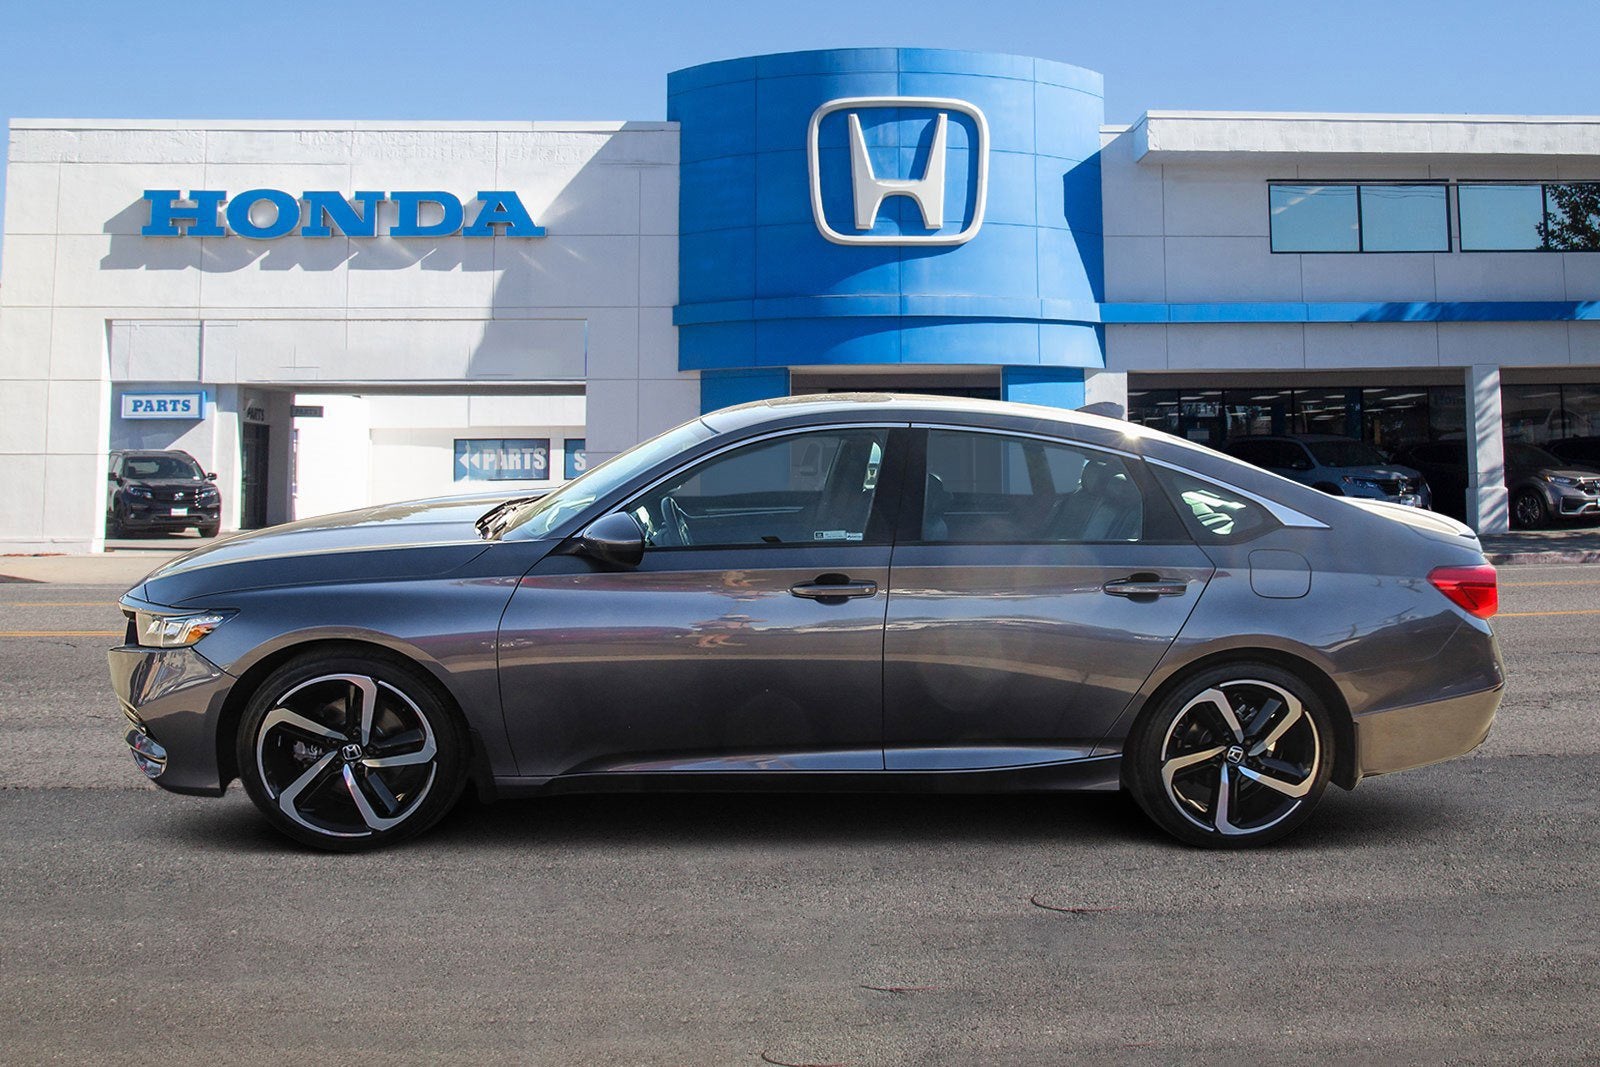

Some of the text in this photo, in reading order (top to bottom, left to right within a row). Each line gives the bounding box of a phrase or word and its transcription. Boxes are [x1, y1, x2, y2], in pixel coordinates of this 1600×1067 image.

[141, 189, 547, 240] HONDA
[131, 399, 191, 412] PARTS
[482, 448, 546, 471] PARTS
